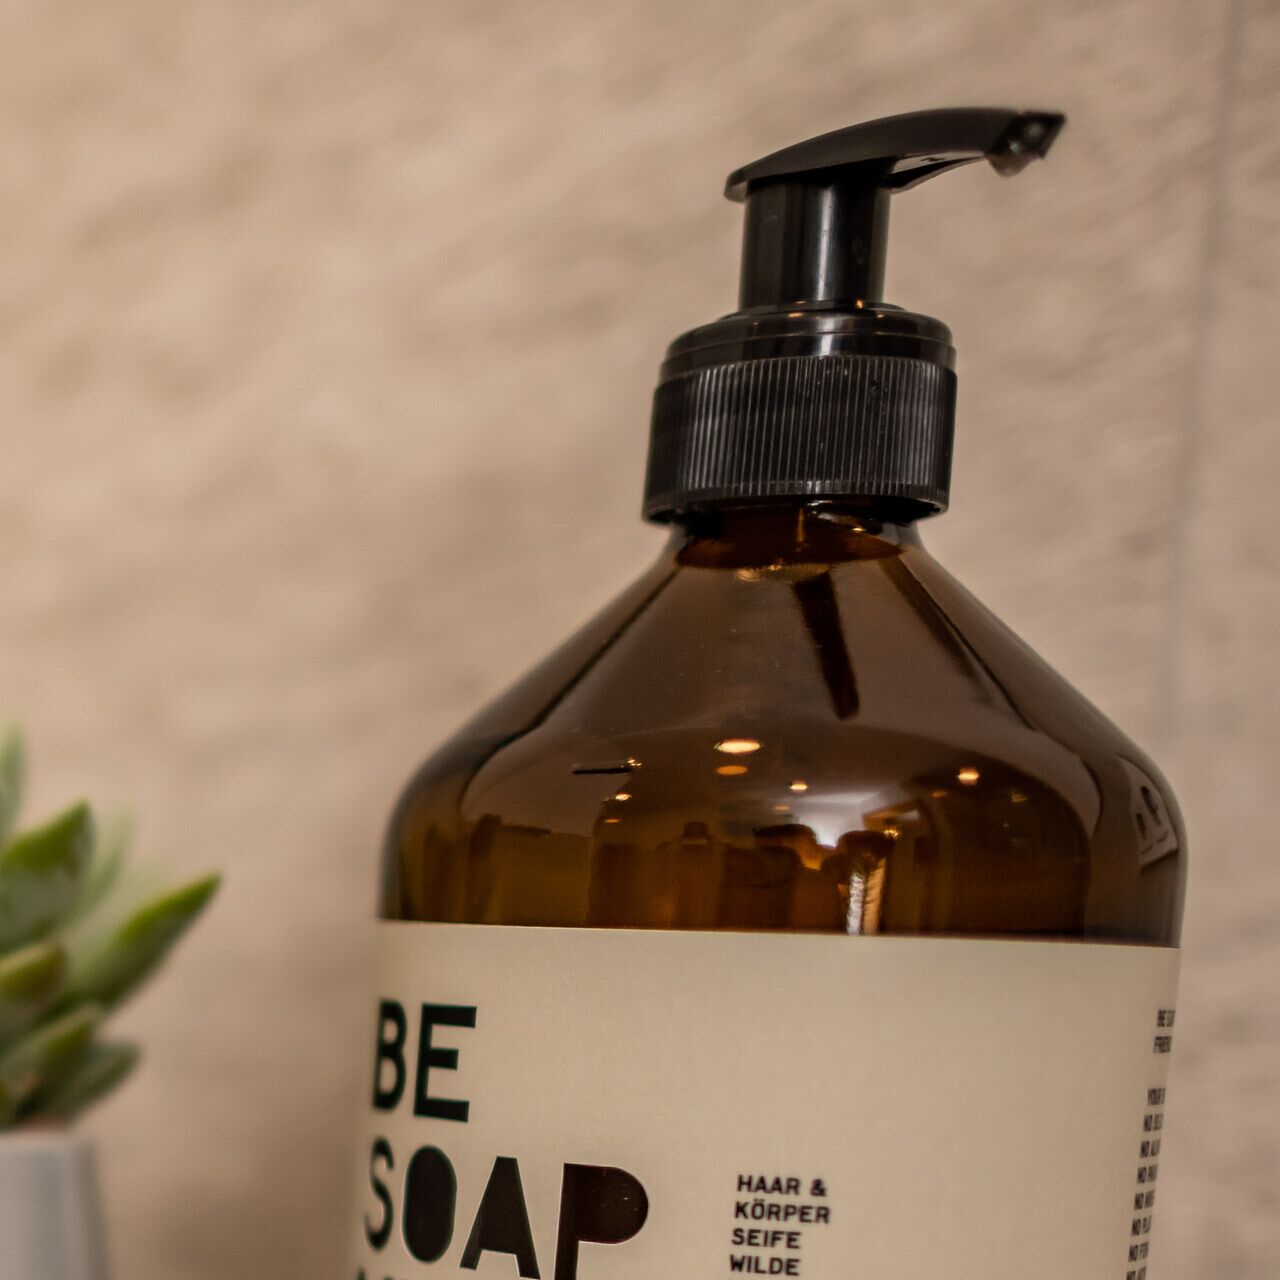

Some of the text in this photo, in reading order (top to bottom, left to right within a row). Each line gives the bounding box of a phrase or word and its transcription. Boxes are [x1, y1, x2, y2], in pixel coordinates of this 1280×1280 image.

[371, 998, 477, 1123] BE
[737, 1174, 826, 1197] HAAR &
[734, 1199, 831, 1224] KÖRPER
[731, 1228, 801, 1249] SEIFE
[729, 1254, 800, 1276] WILDE
